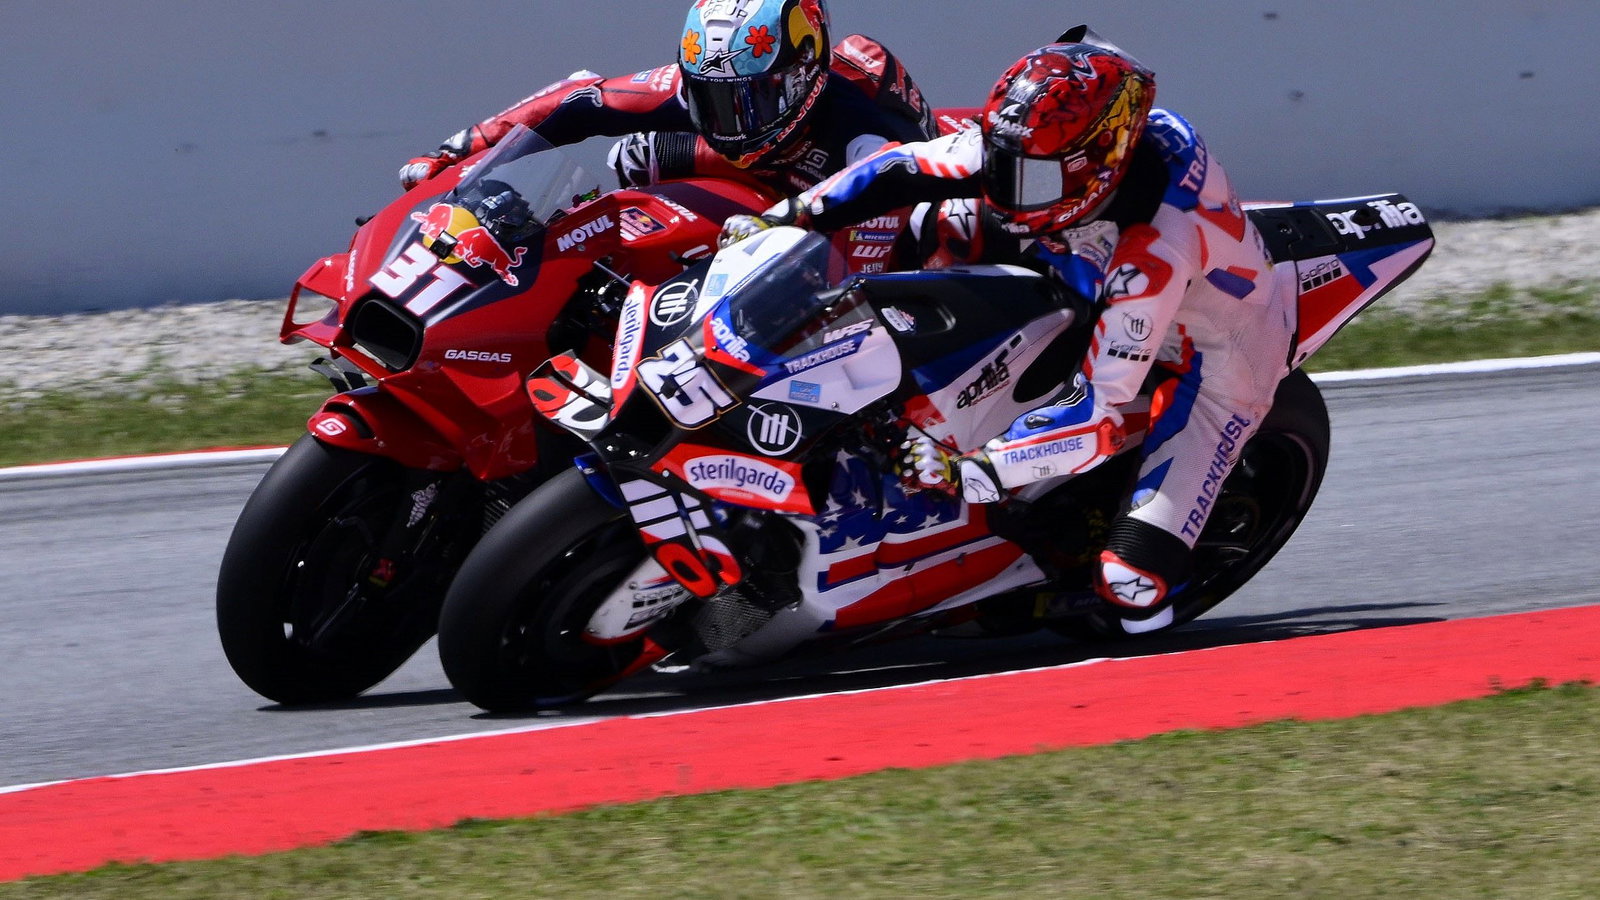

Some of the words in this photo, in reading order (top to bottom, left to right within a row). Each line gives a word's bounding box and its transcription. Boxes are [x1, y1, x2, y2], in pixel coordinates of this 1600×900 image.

[556, 214, 615, 252] MOTUL
[365, 241, 478, 317] 31
[1299, 259, 1340, 281] GoPro
[444, 349, 513, 363] GASGAS
[614, 299, 640, 383] sterilgarda
[784, 340, 856, 374] TRACKHOUSE
[957, 361, 1010, 409] aprilia
[1002, 437, 1084, 466] TRACKHOUSE
[690, 458, 787, 495] sterilgarda
